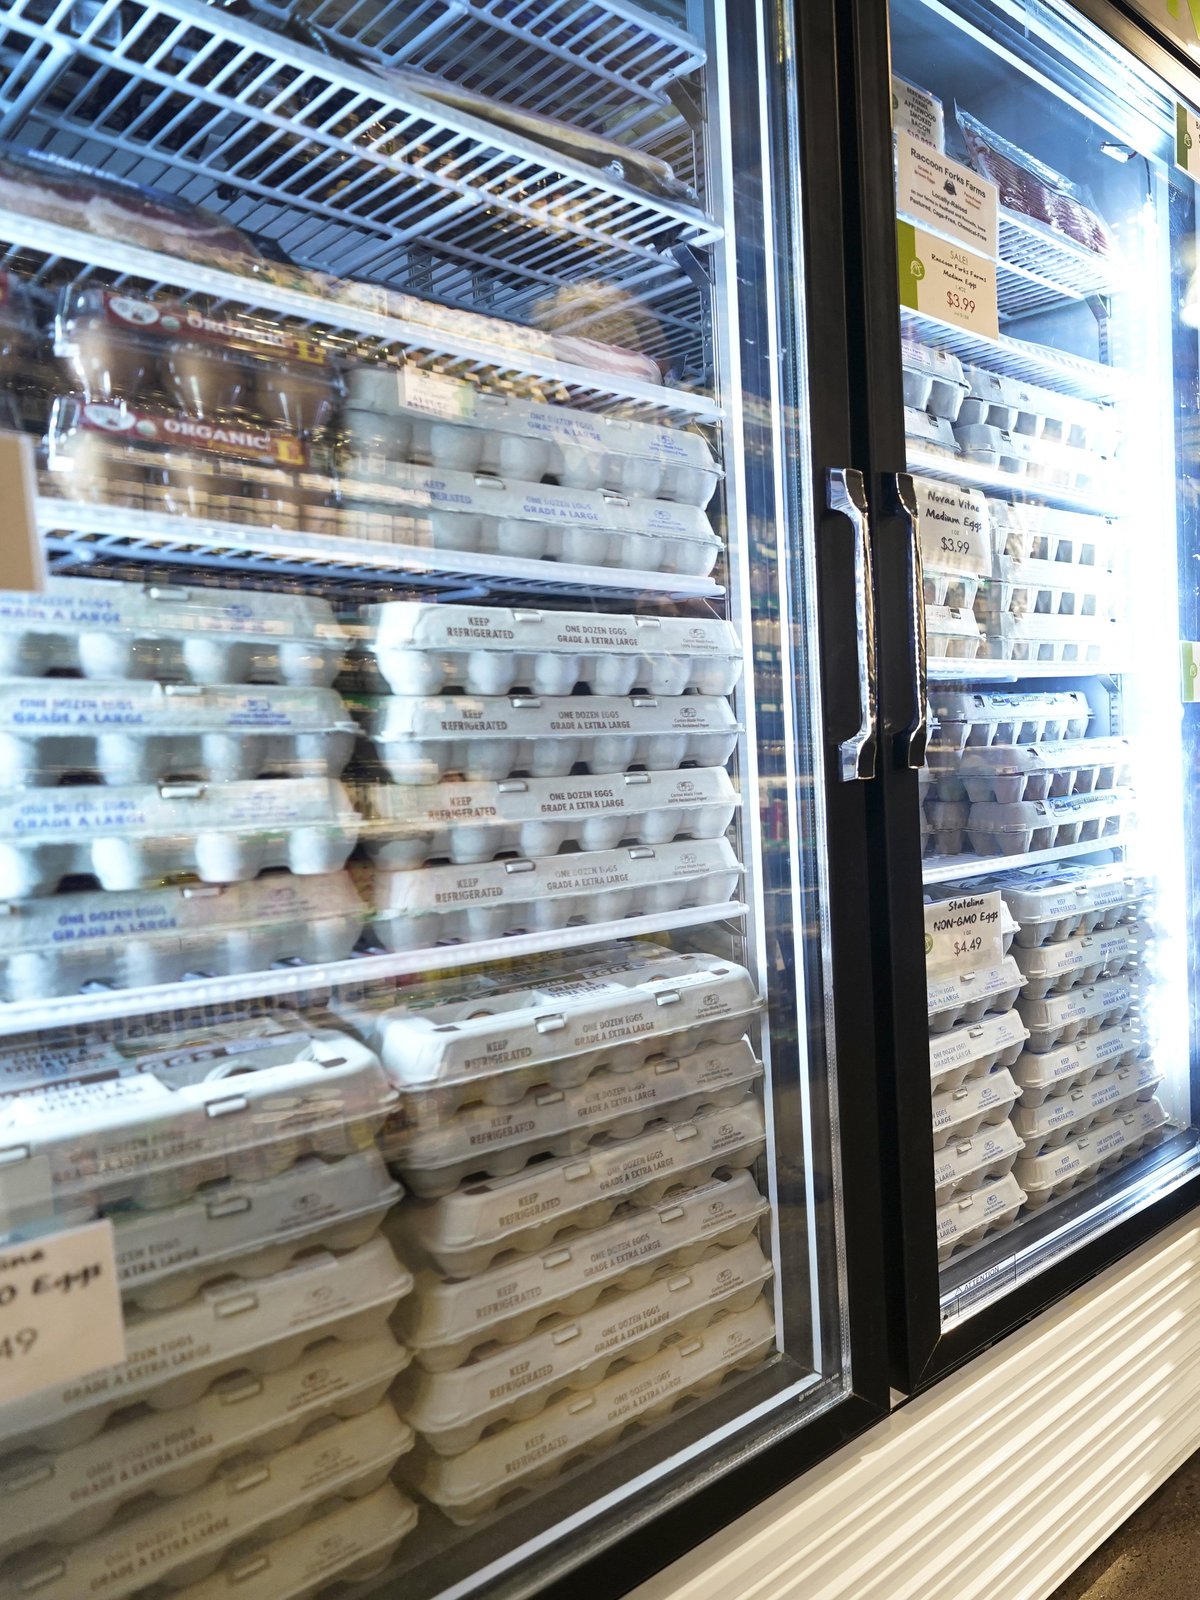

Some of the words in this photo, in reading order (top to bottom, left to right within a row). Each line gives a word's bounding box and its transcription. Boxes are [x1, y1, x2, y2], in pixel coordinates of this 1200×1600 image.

[904, 100, 936, 123] APPLEWOOD
[910, 110, 932, 127] SMOKED
[911, 119, 931, 134] BACON
[910, 148, 944, 173] Raccoon
[945, 168, 965, 185] Forks
[966, 180, 986, 198] Farms
[932, 190, 968, 214] Locally-Raised
[910, 196, 932, 213] Pastured,
[933, 209, 957, 226] Cage-Free,
[957, 222, 987, 241] Chemical-Free
[931, 254, 953, 268] Raccoon
[955, 264, 969, 275] Forks
[970, 271, 987, 283] Farms
[943, 269, 963, 282] Medium
[965, 279, 977, 290] Eggs
[946, 290, 976, 314] $3.99
[186, 314, 286, 347] ORGANIC
[163, 419, 271, 449] ORGANIC
[928, 491, 955, 506] Novae
[959, 499, 979, 512] Vitae
[523, 505, 557, 516] GRADE
[569, 511, 599, 521] LARGE
[926, 508, 960, 524] Medium
[964, 517, 982, 532] Eggs
[941, 536, 970, 554] $3.99
[468, 617, 490, 626] KEEP
[447, 627, 514, 639] REFRIGERATED
[565, 625, 581, 633] ONE
[582, 626, 607, 635] DOZEN
[608, 627, 627, 635] EGGS
[557, 635, 583, 643] GRADE
[585, 636, 590, 644] A
[591, 637, 614, 645] EXTRA
[616, 638, 638, 646] LARGE
[13, 713, 69, 723] GRADE
[78, 714, 86, 722] A
[94, 714, 143, 723] LARGE
[558, 711, 574, 719] ONE
[575, 711, 600, 719] DOZEN
[441, 721, 508, 730] REFRIGERATED
[550, 722, 576, 730] GRADE
[584, 721, 607, 729] EXTRA
[549, 792, 566, 801] ONE
[567, 790, 593, 799] DOZEN
[594, 789, 614, 798] EGGS
[541, 803, 568, 813] GRADE
[569, 802, 575, 810] A
[576, 801, 600, 810] EXTRA
[601, 799, 625, 808] LARGE
[456, 877, 479, 889] KEEP
[547, 881, 573, 890] GRADE
[574, 879, 580, 887] A
[582, 877, 605, 886] EXTRA
[607, 874, 629, 883] LARGE
[435, 887, 503, 903] REFRIGERATED
[948, 897, 984, 912] Stateline
[933, 913, 976, 932] NON-GMO
[980, 911, 998, 923] Eggs
[53, 927, 106, 942] GRADE
[114, 925, 125, 935] A
[129, 918, 178, 931] LARGE
[954, 936, 982, 957] $4.49
[583, 1023, 598, 1033] ONE
[600, 1018, 624, 1029] DOZEN
[625, 1013, 644, 1024] EGGS
[574, 1034, 600, 1046] GRADE
[601, 1032, 607, 1040] A
[608, 1027, 631, 1040] EXTRA
[632, 1022, 655, 1034] LARGE
[486, 1039, 509, 1053] KEEP
[935, 1116, 951, 1126] LARGE
[600, 1177, 624, 1191] GRADE
[624, 1174, 630, 1182] A
[631, 1167, 652, 1179] EXTRA
[653, 1158, 675, 1171] LARGE
[939, 1170, 955, 1181] LARGE
[518, 1193, 539, 1207] KEEP
[939, 1226, 957, 1238] LARGE
[32, 1263, 103, 1294] Eggs
[964, 1265, 1000, 1290] ATTENTION
[509, 1361, 531, 1377] KEEP
[489, 1364, 554, 1400] REFRIGERATED
